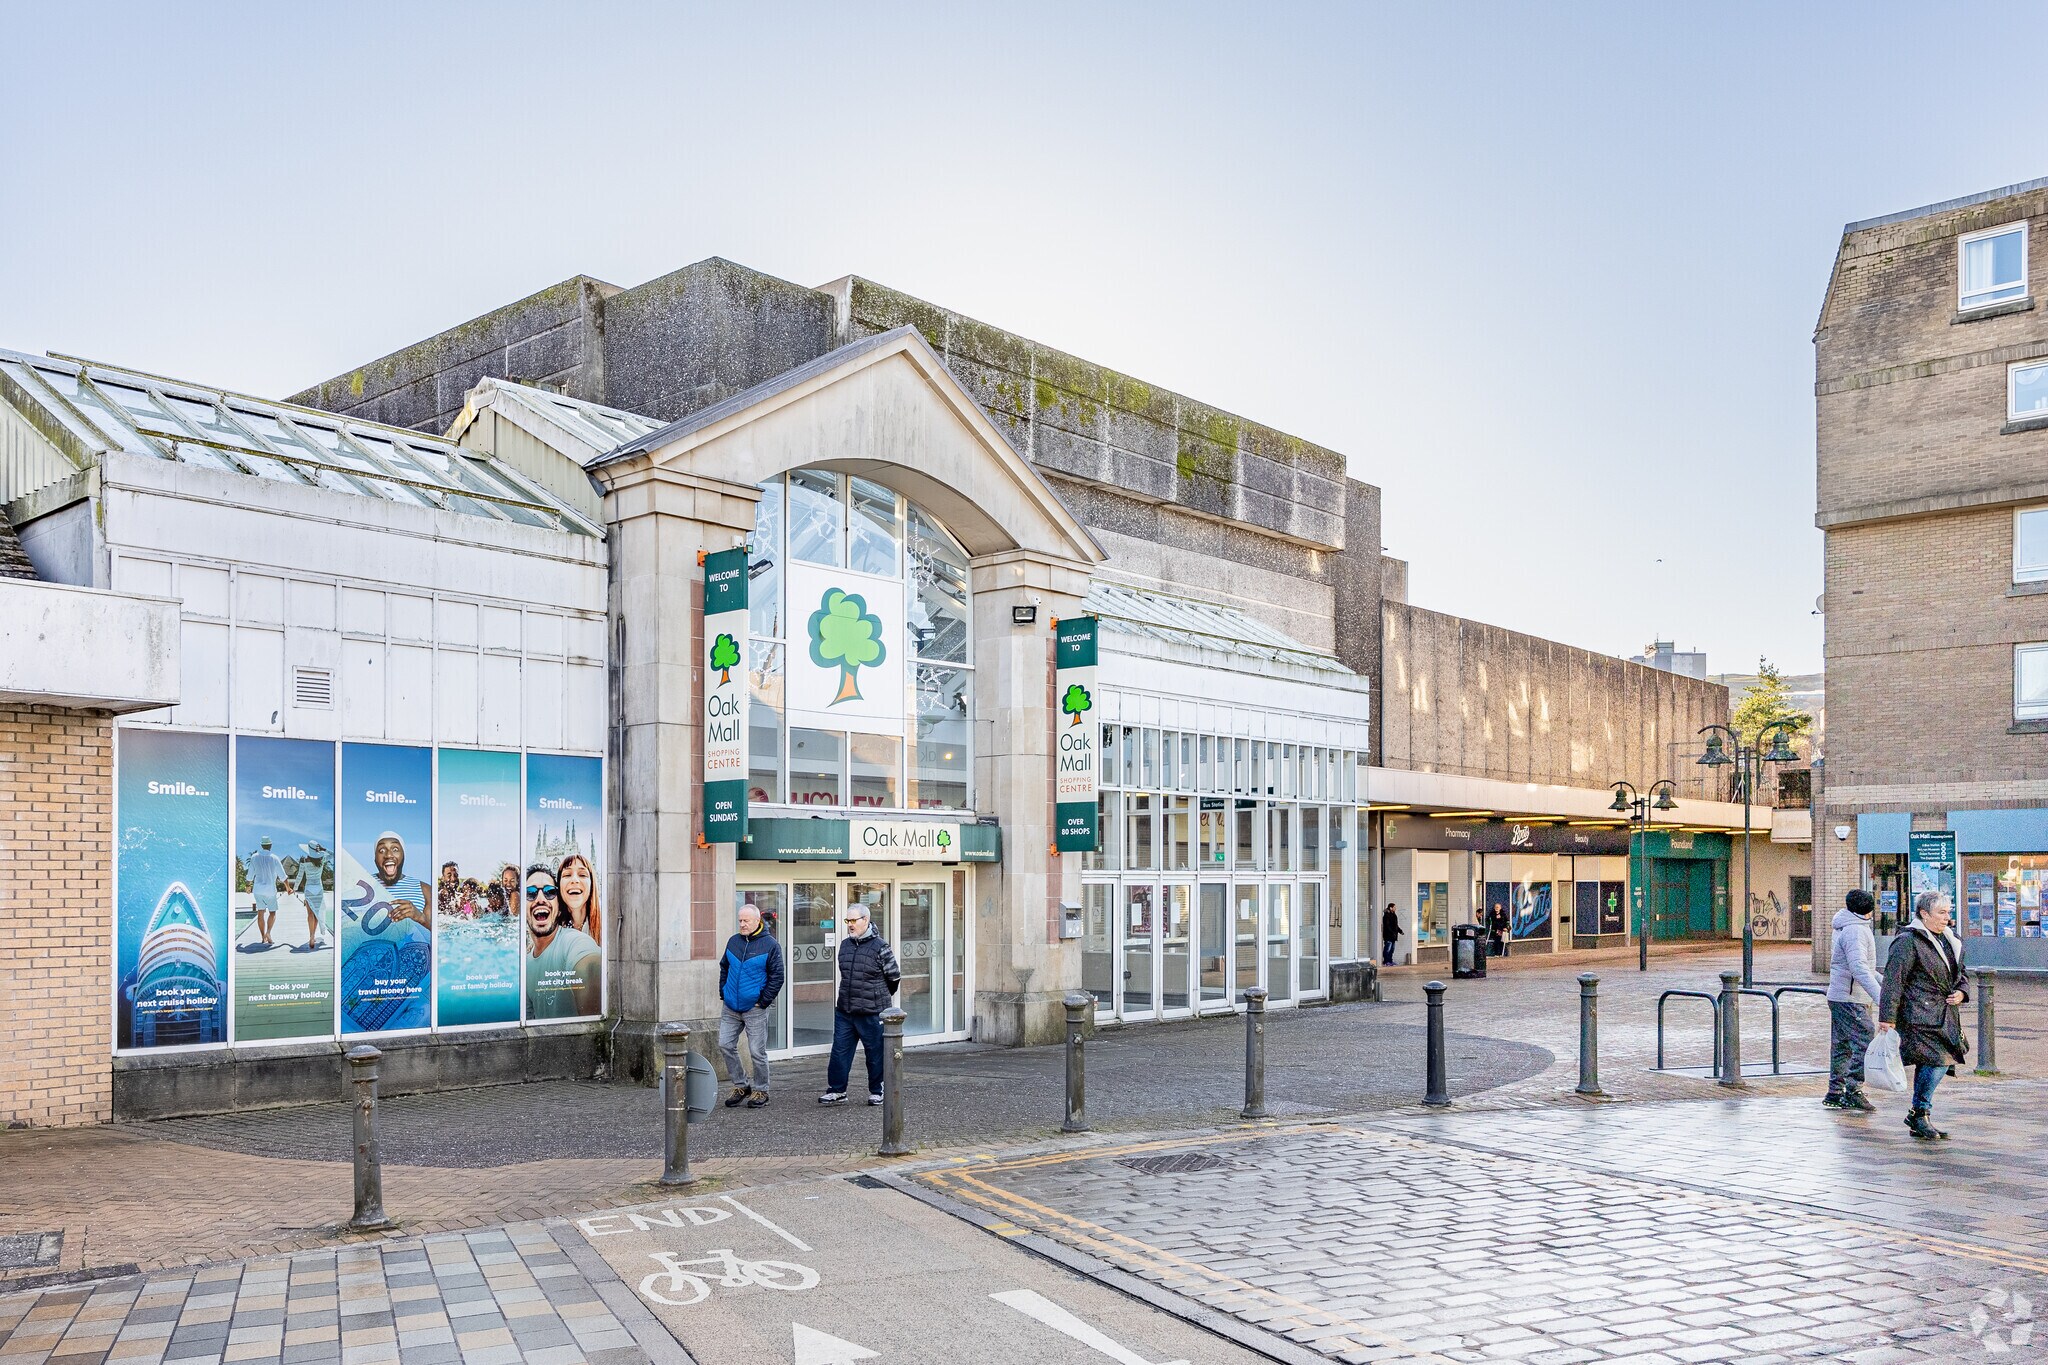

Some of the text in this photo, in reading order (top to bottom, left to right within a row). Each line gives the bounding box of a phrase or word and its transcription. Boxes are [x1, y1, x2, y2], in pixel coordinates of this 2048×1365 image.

[709, 568, 740, 583] WELCOME
[720, 583, 729, 592] TO
[1061, 633, 1091, 644] WELCOME
[1071, 643, 1080, 652] TO
[708, 694, 740, 718] Oak
[708, 719, 740, 743] Mall
[1060, 733, 1091, 751] Oak
[707, 748, 740, 757] SHOPPING
[707, 757, 740, 769] CENTRE
[1060, 754, 1091, 772] Mall
[1060, 776, 1092, 784] SHOPPING
[148, 781, 209, 796] Smile...
[262, 785, 318, 800] Smile...
[1059, 784, 1092, 793] CENTRE
[365, 790, 417, 804] Smile...
[460, 793, 507, 807] Smile...
[539, 797, 582, 810] Smile...
[715, 801, 733, 810] OPEN
[709, 812, 738, 822] SUNDAYS
[1067, 818, 1084, 826] OVER
[863, 826, 934, 847] Oak Mall
[1061, 827, 1090, 836] 80 SHOPS
[1445, 828, 1470, 838] Pharmacy
[1511, 824, 1530, 846] Boots
[1575, 834, 1589, 845] Beauty
[778, 846, 843, 855] www.oakmall.co.uk
[341, 880, 394, 936] 20
[560, 969, 576, 978] your
[269, 982, 310, 992] book your
[374, 977, 407, 986] buy your
[552, 978, 564, 986] city
[156, 987, 200, 998] book your
[248, 991, 329, 1002] next faraway holiday
[358, 988, 380, 996] travel
[136, 996, 218, 1008] next cruise holiday
[577, 1206, 734, 1237] END
